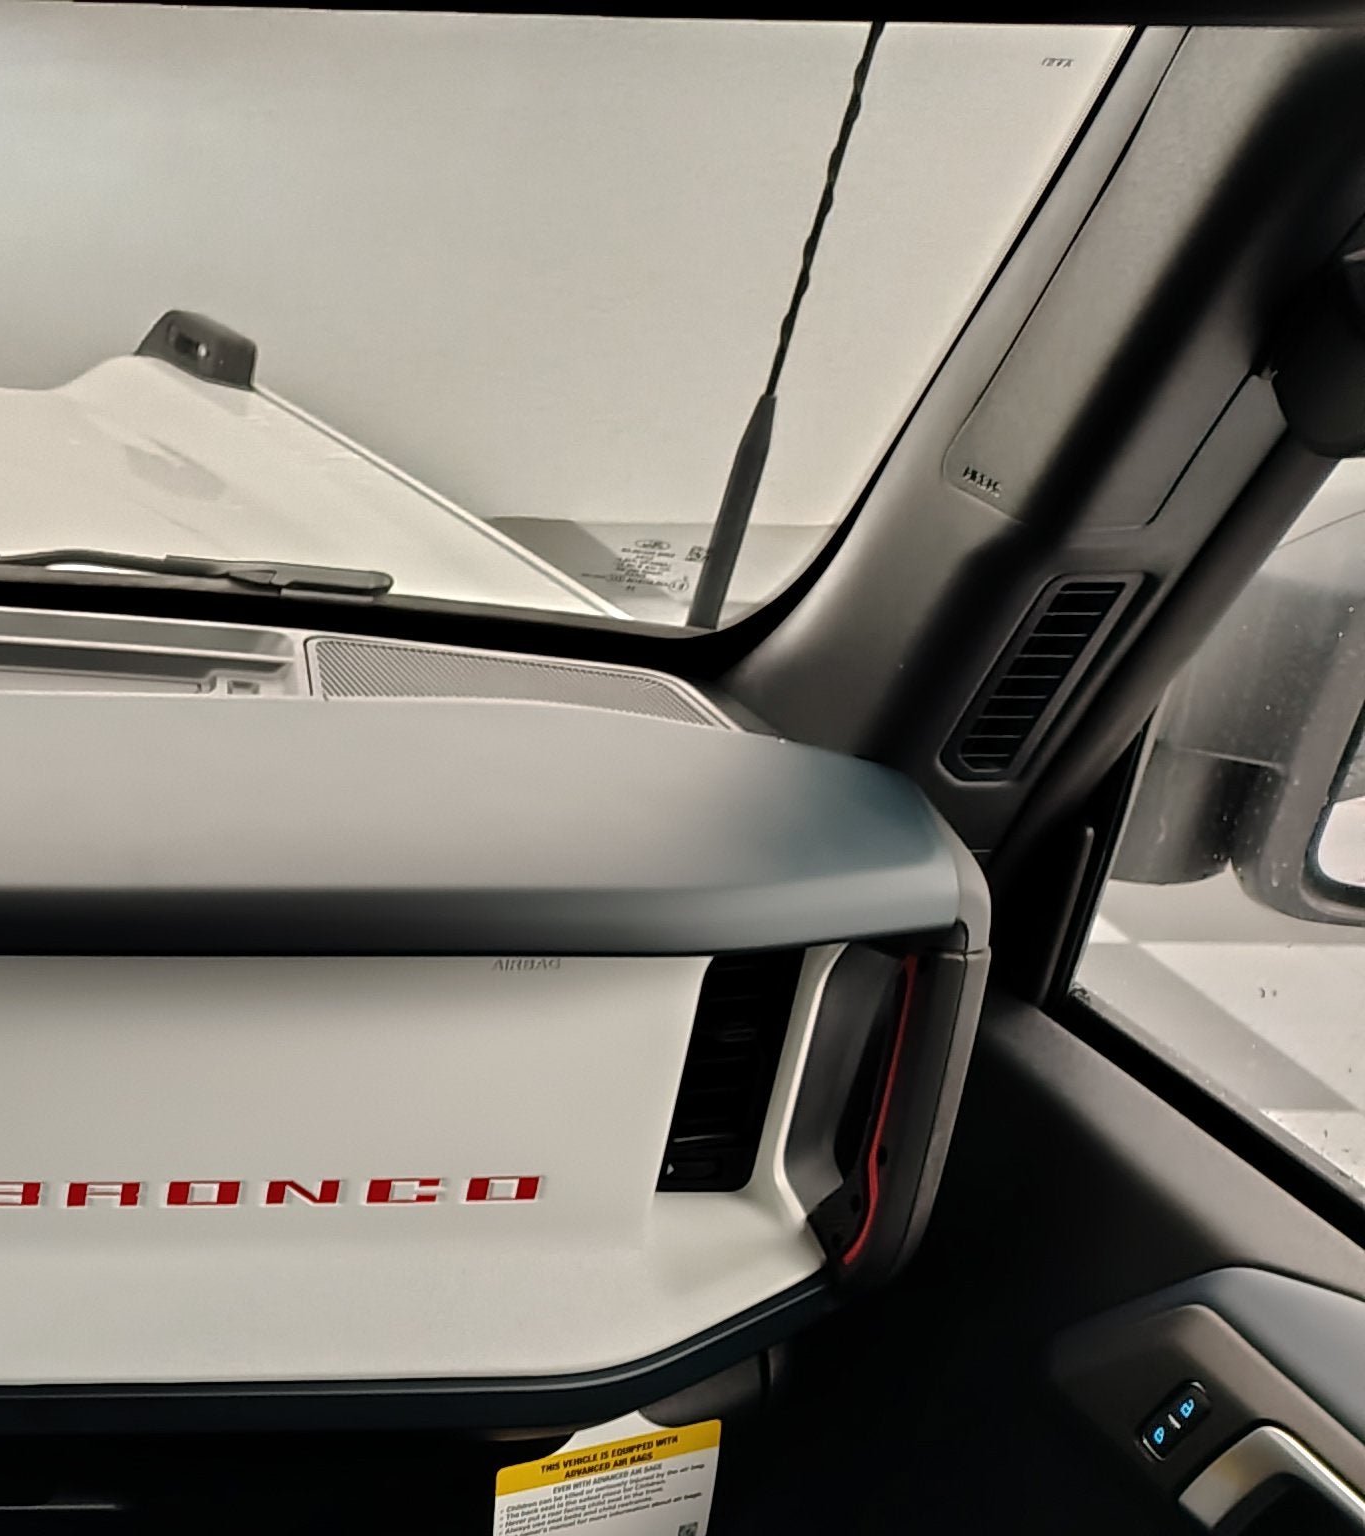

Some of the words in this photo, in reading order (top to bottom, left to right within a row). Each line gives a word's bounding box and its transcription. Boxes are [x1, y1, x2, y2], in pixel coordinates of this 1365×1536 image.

[541, 1463, 559, 1473] THIS
[563, 1454, 597, 1468] VEHICLE
[600, 1452, 608, 1460] IS
[655, 1436, 677, 1447] WITH
[565, 1461, 610, 1478] ADVANCED
